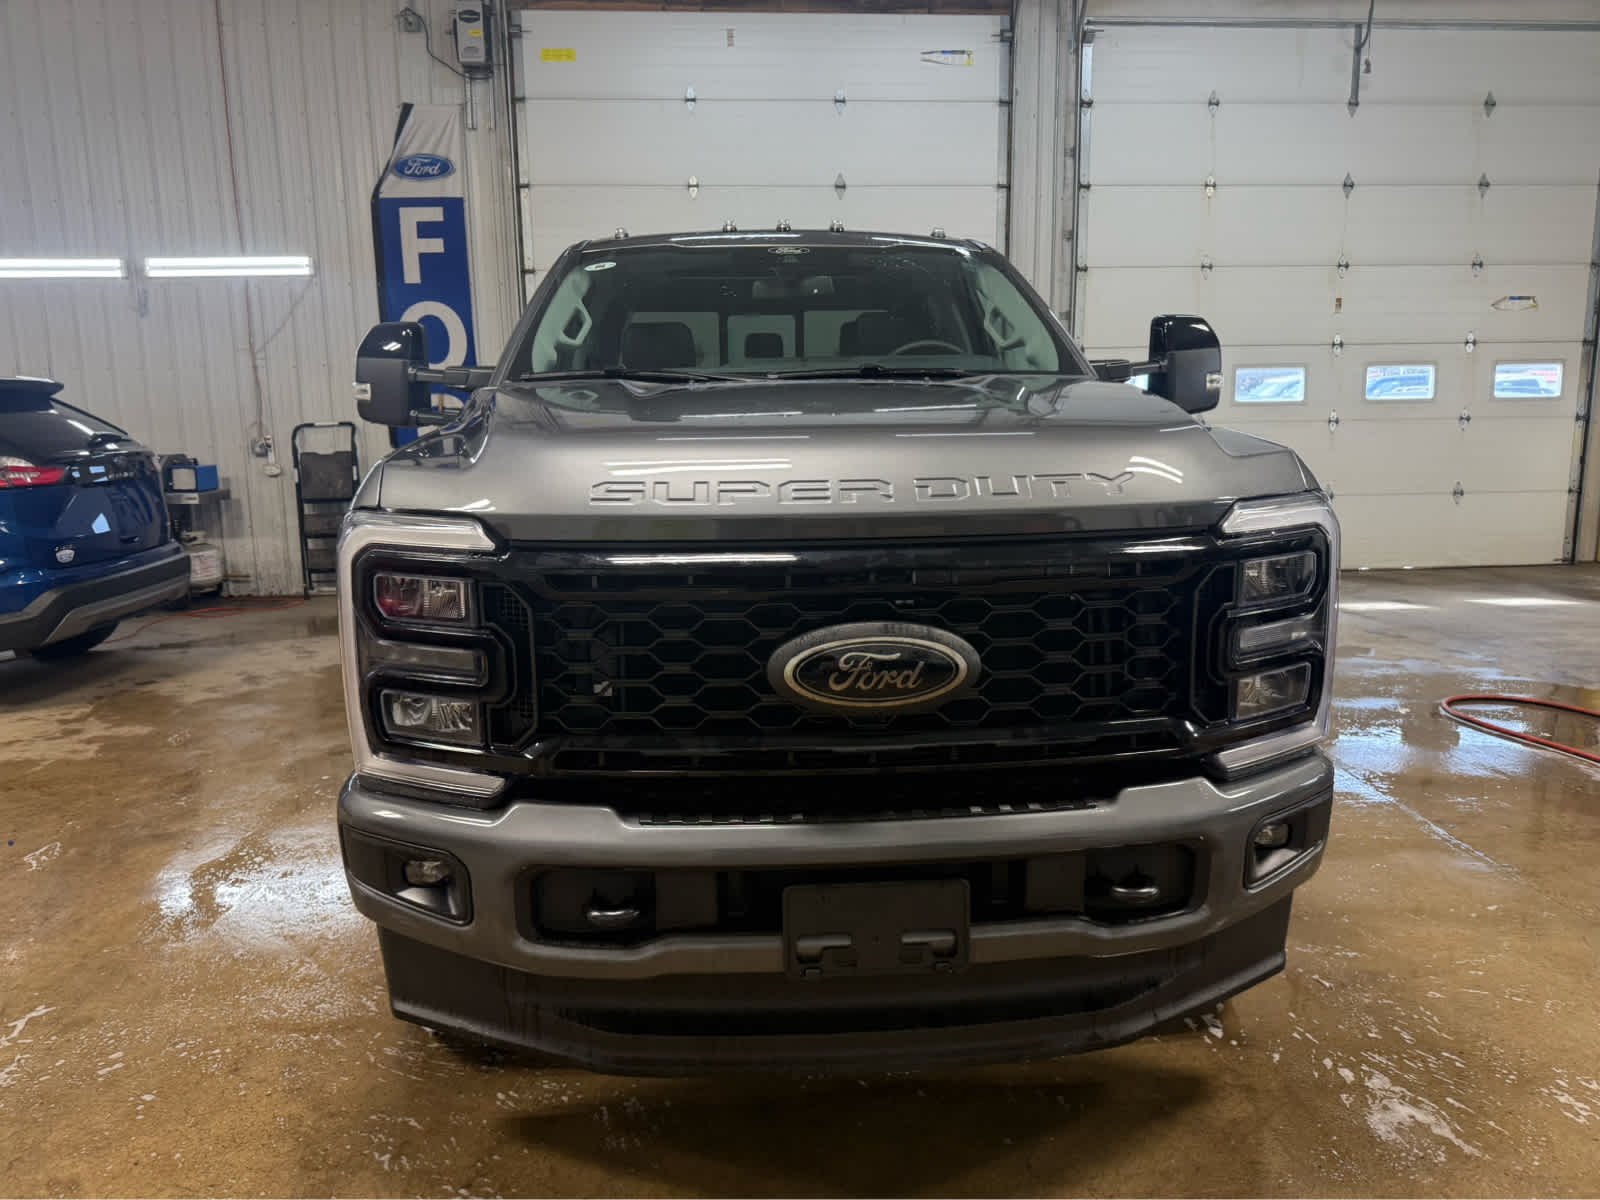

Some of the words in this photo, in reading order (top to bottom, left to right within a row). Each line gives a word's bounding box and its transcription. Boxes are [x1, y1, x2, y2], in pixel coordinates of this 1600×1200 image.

[404, 158, 441, 175] Ford
[589, 480, 895, 505] SUPER
[913, 472, 1135, 501] DUTY
[828, 652, 925, 691] Ford
